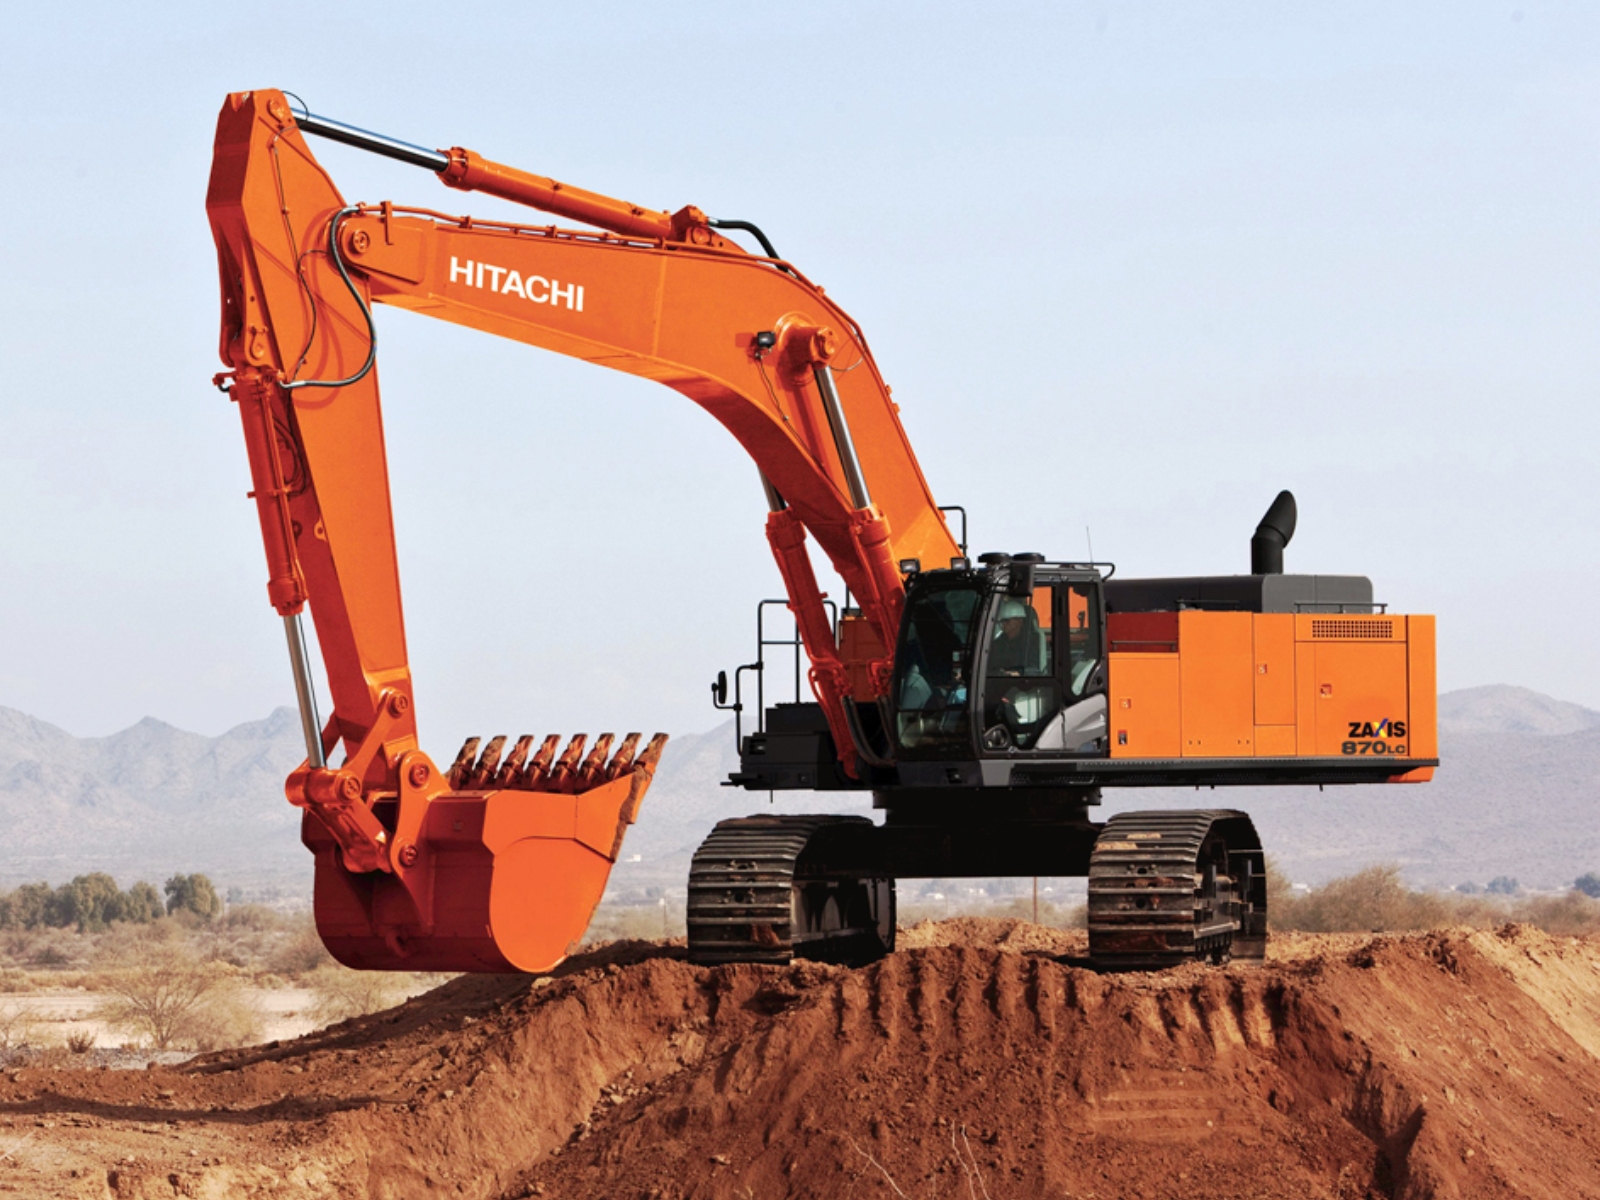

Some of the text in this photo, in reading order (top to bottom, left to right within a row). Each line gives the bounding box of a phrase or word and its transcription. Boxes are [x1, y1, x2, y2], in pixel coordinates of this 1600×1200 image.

[449, 256, 584, 312] HITACHI
[1348, 718, 1406, 738] ZAXIS
[1341, 740, 1406, 755] 870LC
